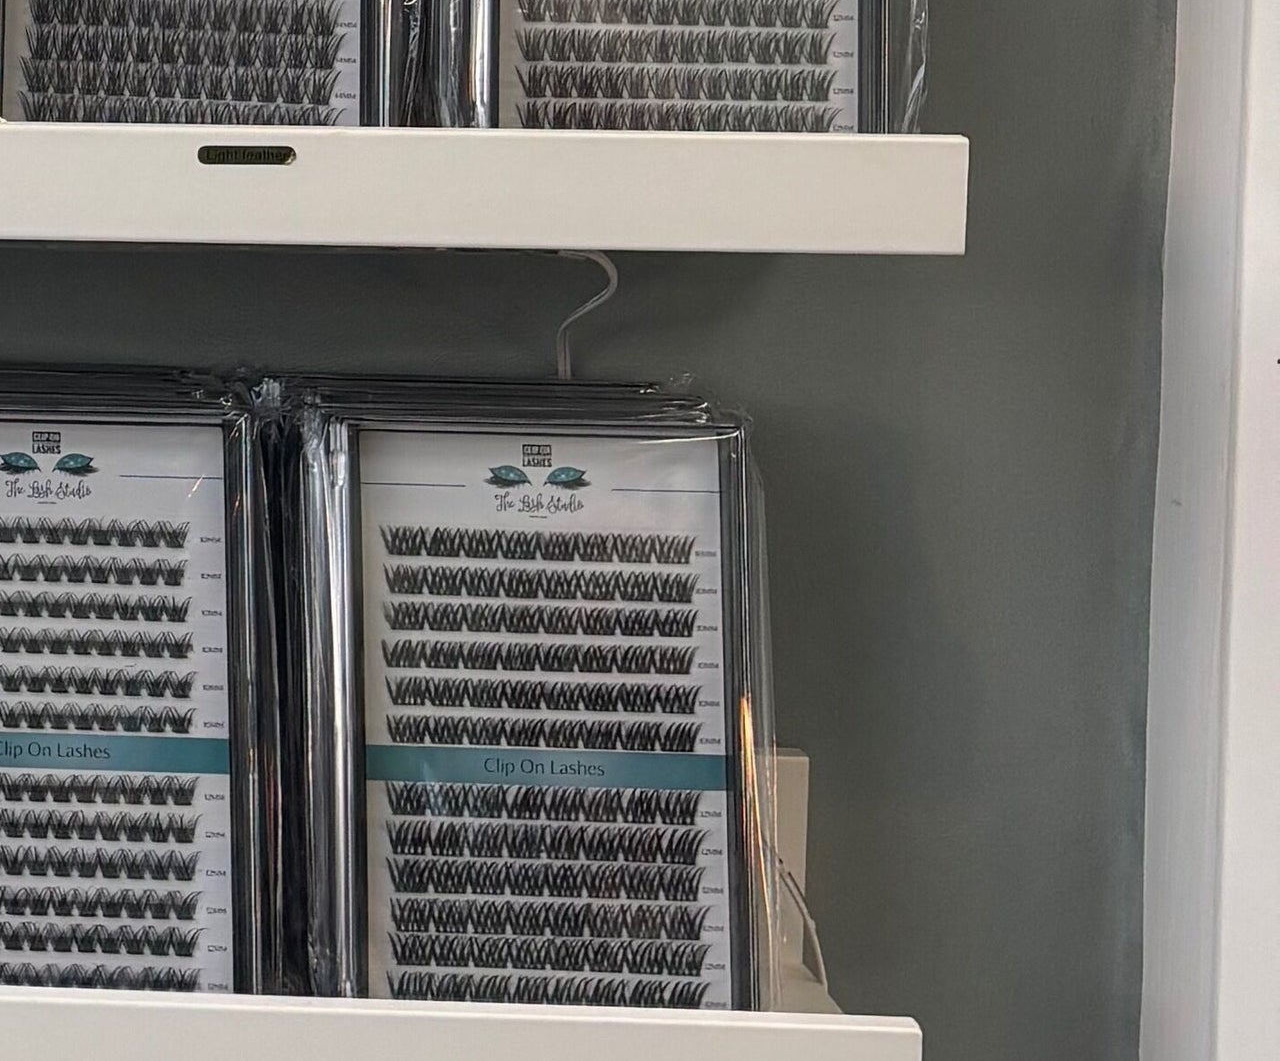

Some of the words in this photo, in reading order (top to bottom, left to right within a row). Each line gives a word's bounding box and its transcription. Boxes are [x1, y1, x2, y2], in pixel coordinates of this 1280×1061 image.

[32, 444, 61, 454] LASHES
[522, 457, 552, 467] LASHES
[27, 741, 51, 757] On
[57, 742, 111, 759] Lashes
[484, 757, 515, 776] Clip
[520, 759, 544, 774] On
[550, 759, 604, 776] Lashes
